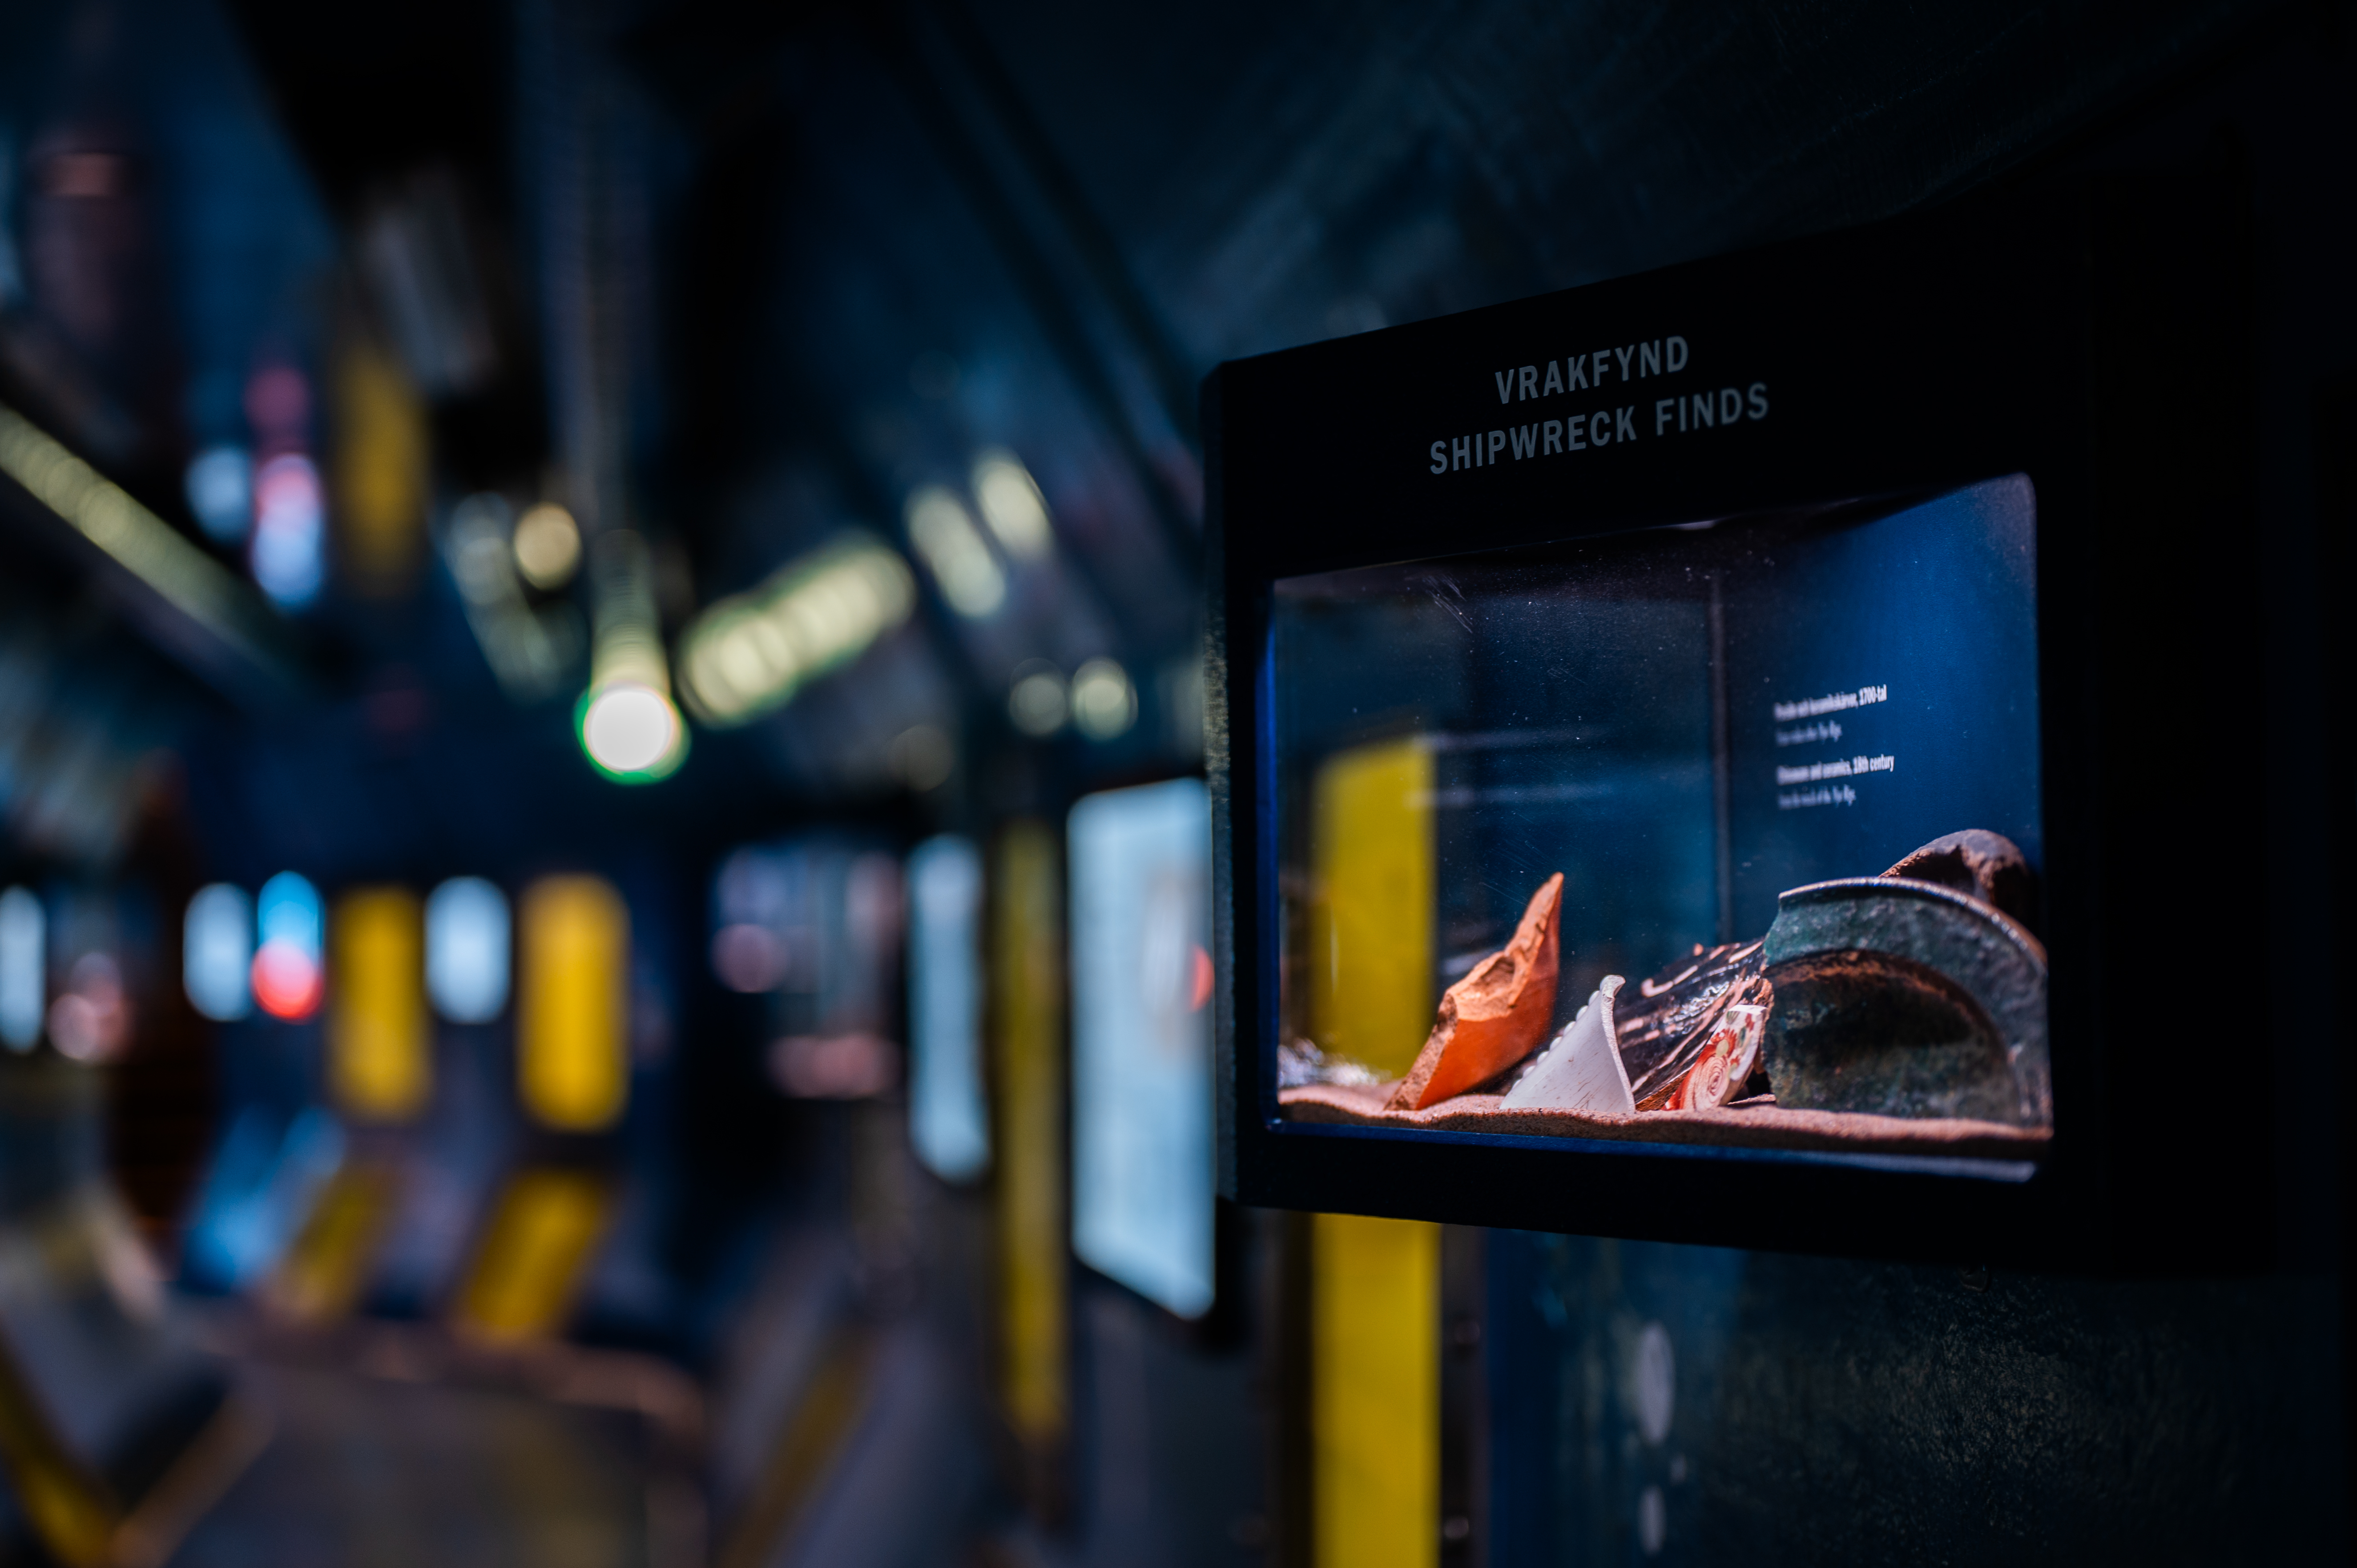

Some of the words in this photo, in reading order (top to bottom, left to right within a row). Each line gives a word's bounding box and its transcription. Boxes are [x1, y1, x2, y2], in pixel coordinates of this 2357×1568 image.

[1495, 336, 1688, 404] VRAKFYND
[1430, 406, 1637, 474] SHIPWRECK
[1656, 382, 1769, 436] FINDS
[1858, 684, 1887, 706] 1700-tal
[1869, 754, 1894, 772] century
